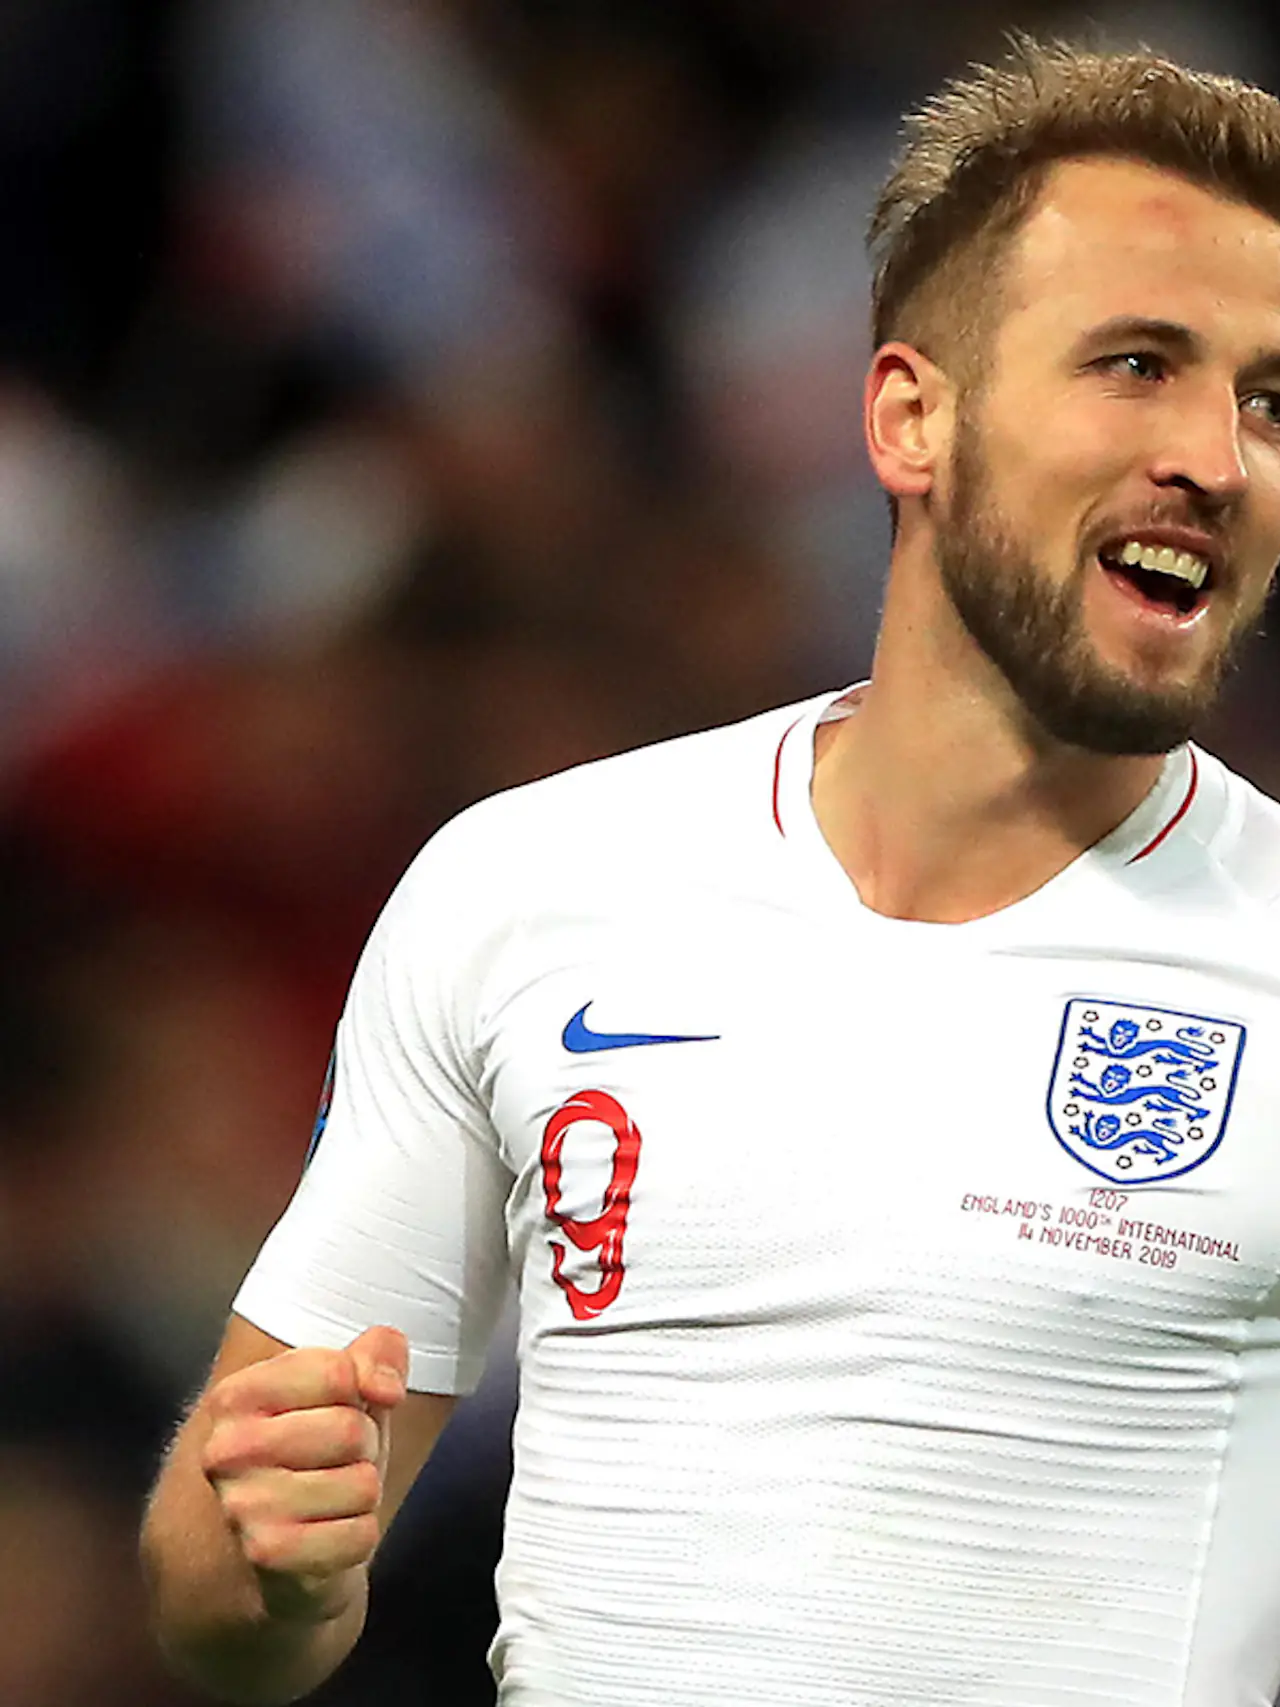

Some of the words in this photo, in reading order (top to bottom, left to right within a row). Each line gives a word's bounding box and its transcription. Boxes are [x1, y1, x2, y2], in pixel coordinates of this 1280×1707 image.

[540, 1089, 642, 1321] 9
[960, 1193, 1053, 1222] ENGLAND'S
[1118, 1219, 1242, 1262] INTERNATIONAL
[1088, 1189, 1129, 1211] 1207
[1018, 1223, 1034, 1242] 14
[1039, 1227, 1133, 1260] NOVEMBER
[1138, 1246, 1178, 1269] 2019
